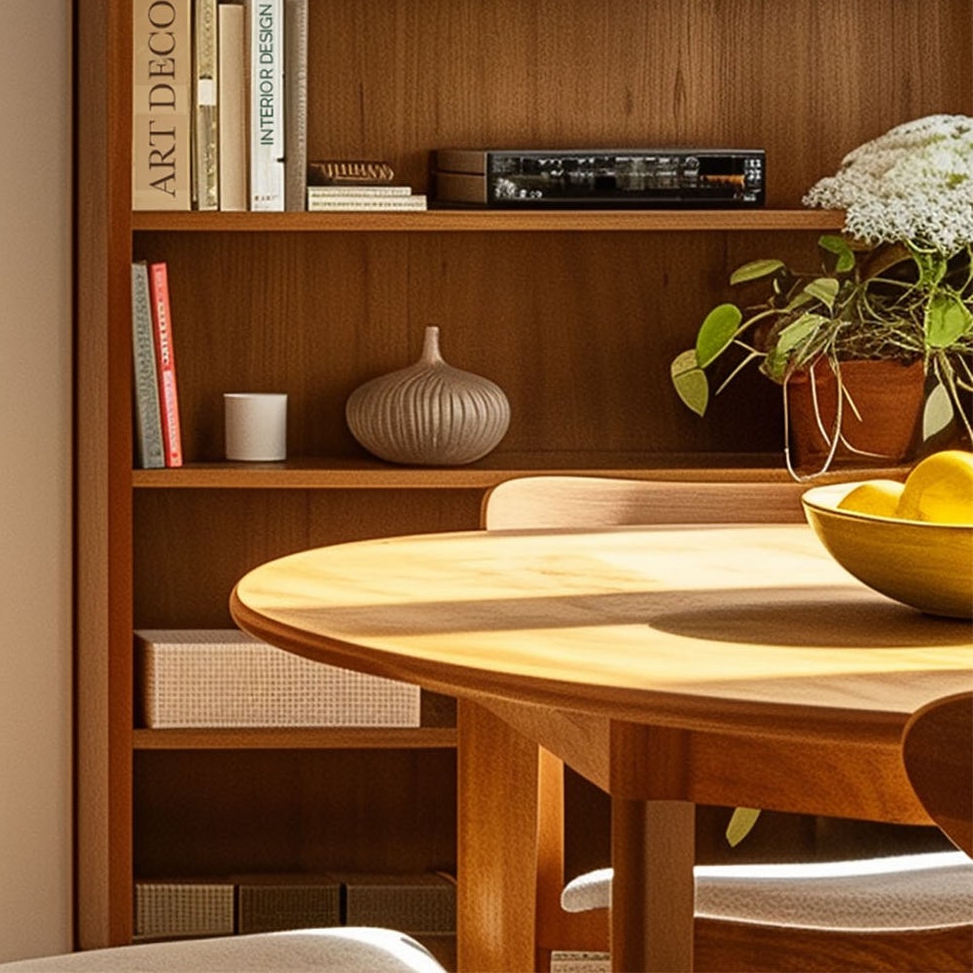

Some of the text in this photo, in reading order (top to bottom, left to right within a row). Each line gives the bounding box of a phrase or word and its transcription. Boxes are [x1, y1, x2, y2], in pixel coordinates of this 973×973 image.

[147, 0, 176, 198] ART DECO
[259, 4, 274, 145] INTERIOR DESIGN
